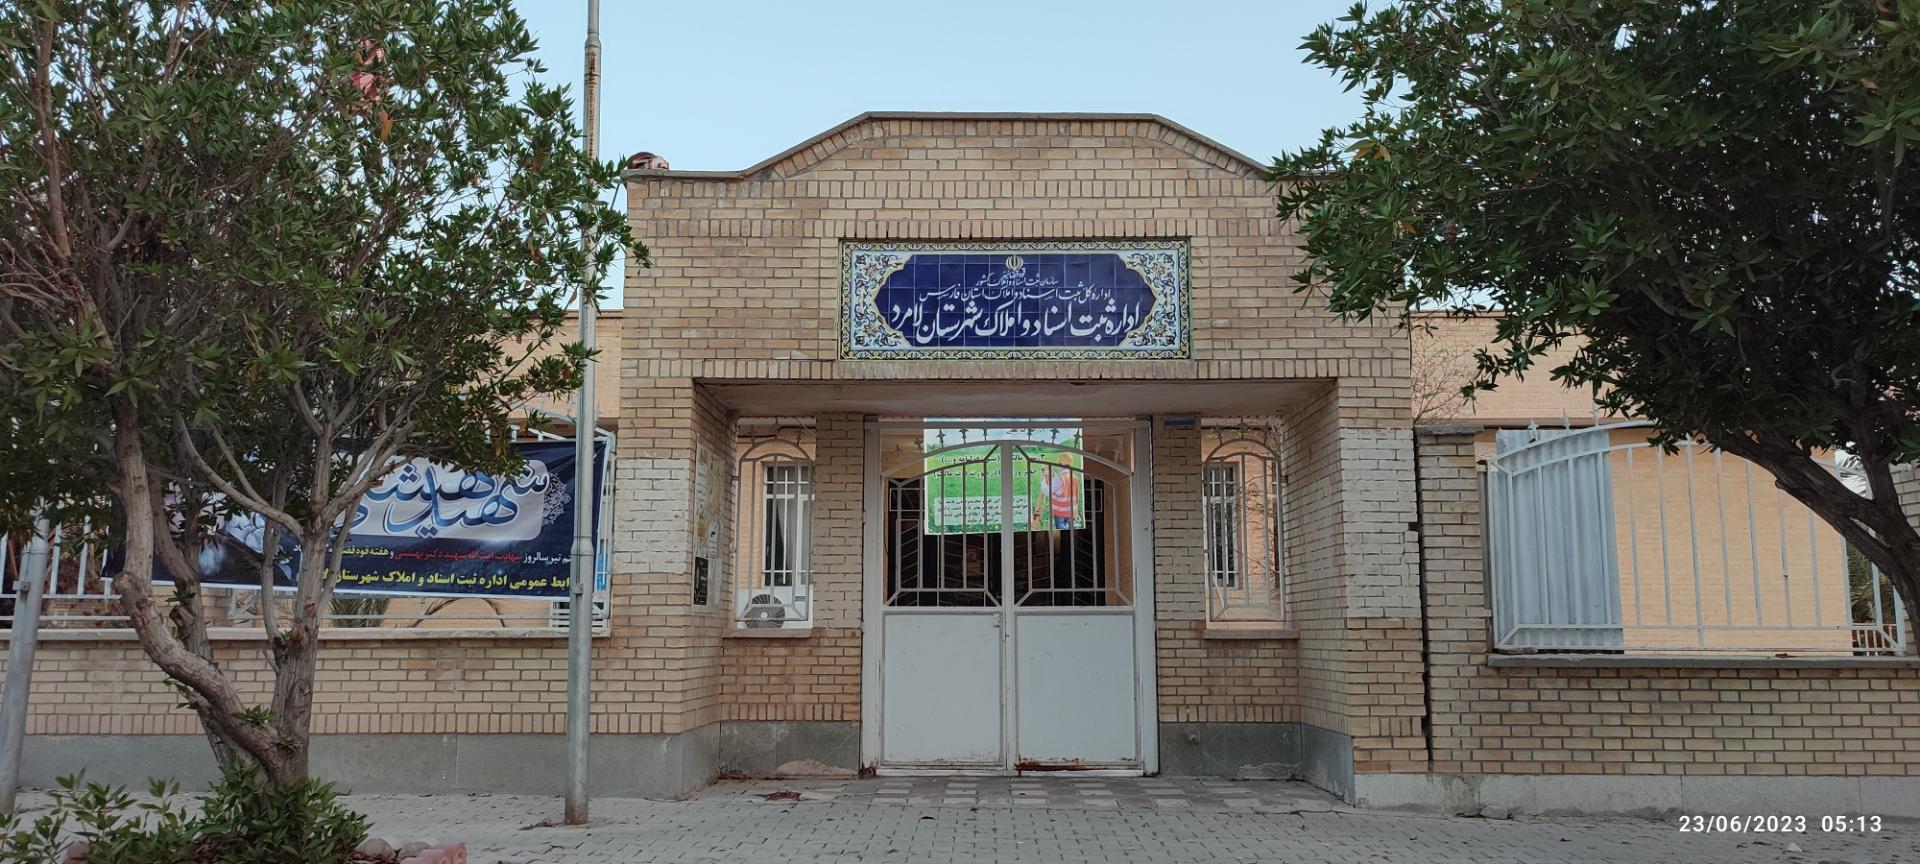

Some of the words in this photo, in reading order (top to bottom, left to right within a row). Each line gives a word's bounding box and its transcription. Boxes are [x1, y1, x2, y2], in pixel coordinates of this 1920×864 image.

[975, 272, 995, 287] کشور
[1025, 272, 1040, 287] ثبت
[1039, 274, 1059, 286] سازمان
[919, 283, 961, 302] فارس
[961, 287, 985, 302] استان
[985, 285, 1014, 301] املاک
[1018, 287, 1058, 301] اسناد
[1058, 281, 1084, 301] ثبت
[1078, 283, 1096, 304] کل
[1090, 287, 1111, 301] اداره
[891, 302, 924, 331] لامرد
[915, 299, 984, 344] شهرستان
[975, 299, 1022, 336] املاک
[1033, 301, 1073, 336] اسناد
[1071, 298, 1117, 342] ثبت
[1105, 302, 1140, 336] اداره
[1020, 318, 1031, 336] و
[355, 546, 369, 558] قوه
[369, 546, 389, 556] هفته
[389, 550, 394, 559] و
[523, 552, 549, 564] سالروز
[549, 553, 562, 565] تیر
[382, 571, 416, 583] املاک
[416, 574, 424, 587] و
[426, 572, 455, 584] اسناد
[456, 572, 477, 585] ثبت
[479, 574, 508, 588] اداره
[509, 578, 547, 590] عمومی
[550, 575, 570, 591] ابط
